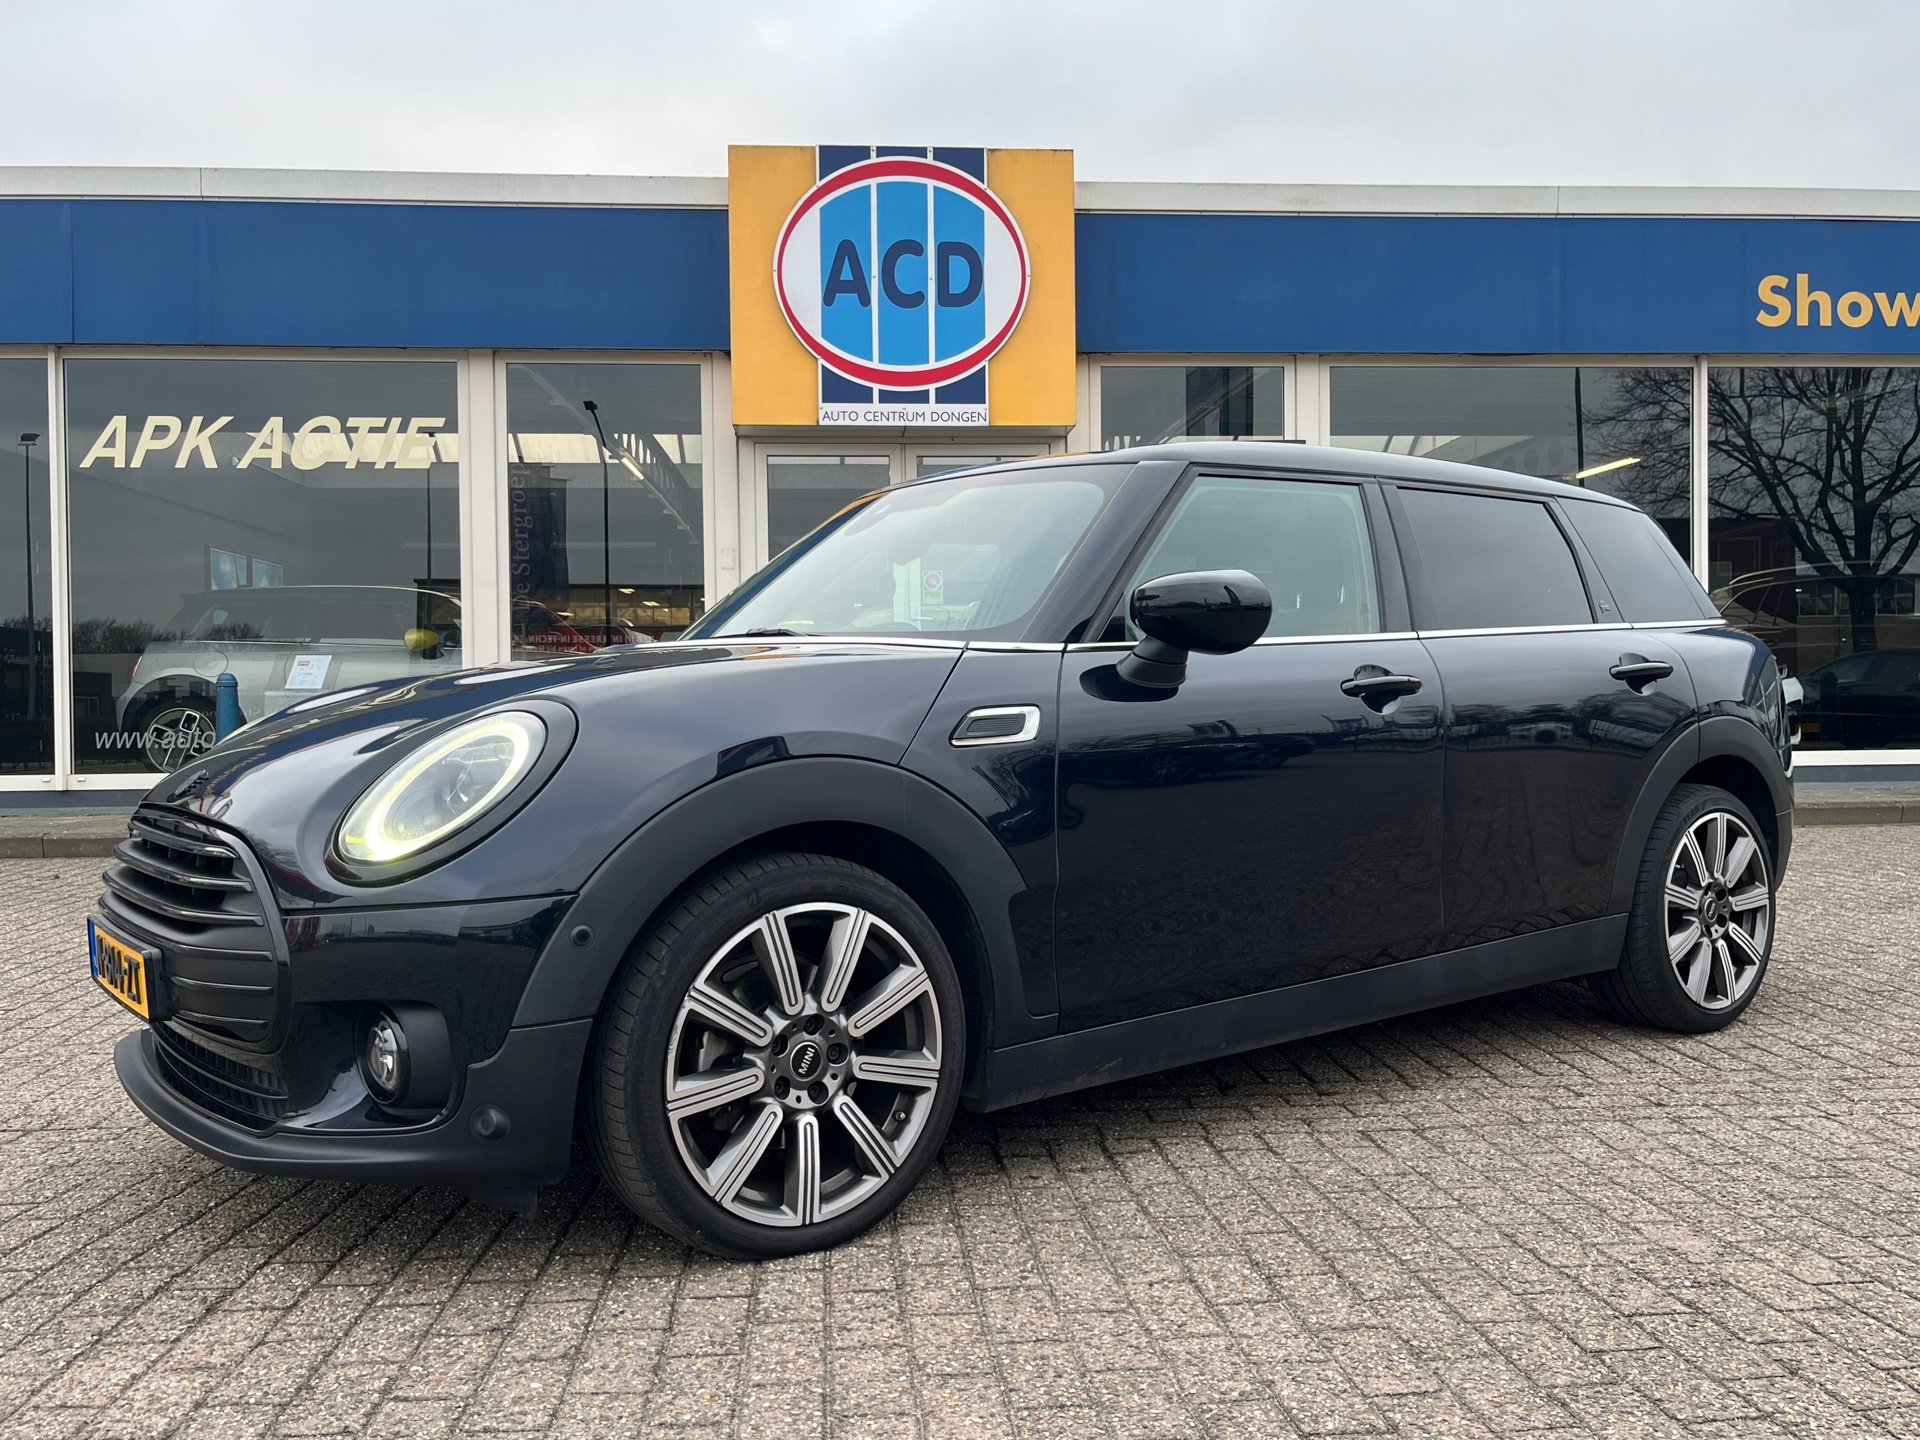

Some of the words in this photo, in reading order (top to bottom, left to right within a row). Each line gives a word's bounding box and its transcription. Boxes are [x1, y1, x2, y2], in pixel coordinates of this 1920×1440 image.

[823, 239, 983, 309] ACD
[1756, 273, 1920, 328] Show
[79, 415, 235, 469] APK
[235, 415, 446, 470] ACTIE
[822, 410, 859, 422] AUTO
[863, 410, 926, 422] CENTRUM
[930, 411, 987, 422] DONGEN
[511, 463, 533, 576] Stergroep
[95, 728, 216, 750] www.auto
[798, 1047, 816, 1075] MINI
